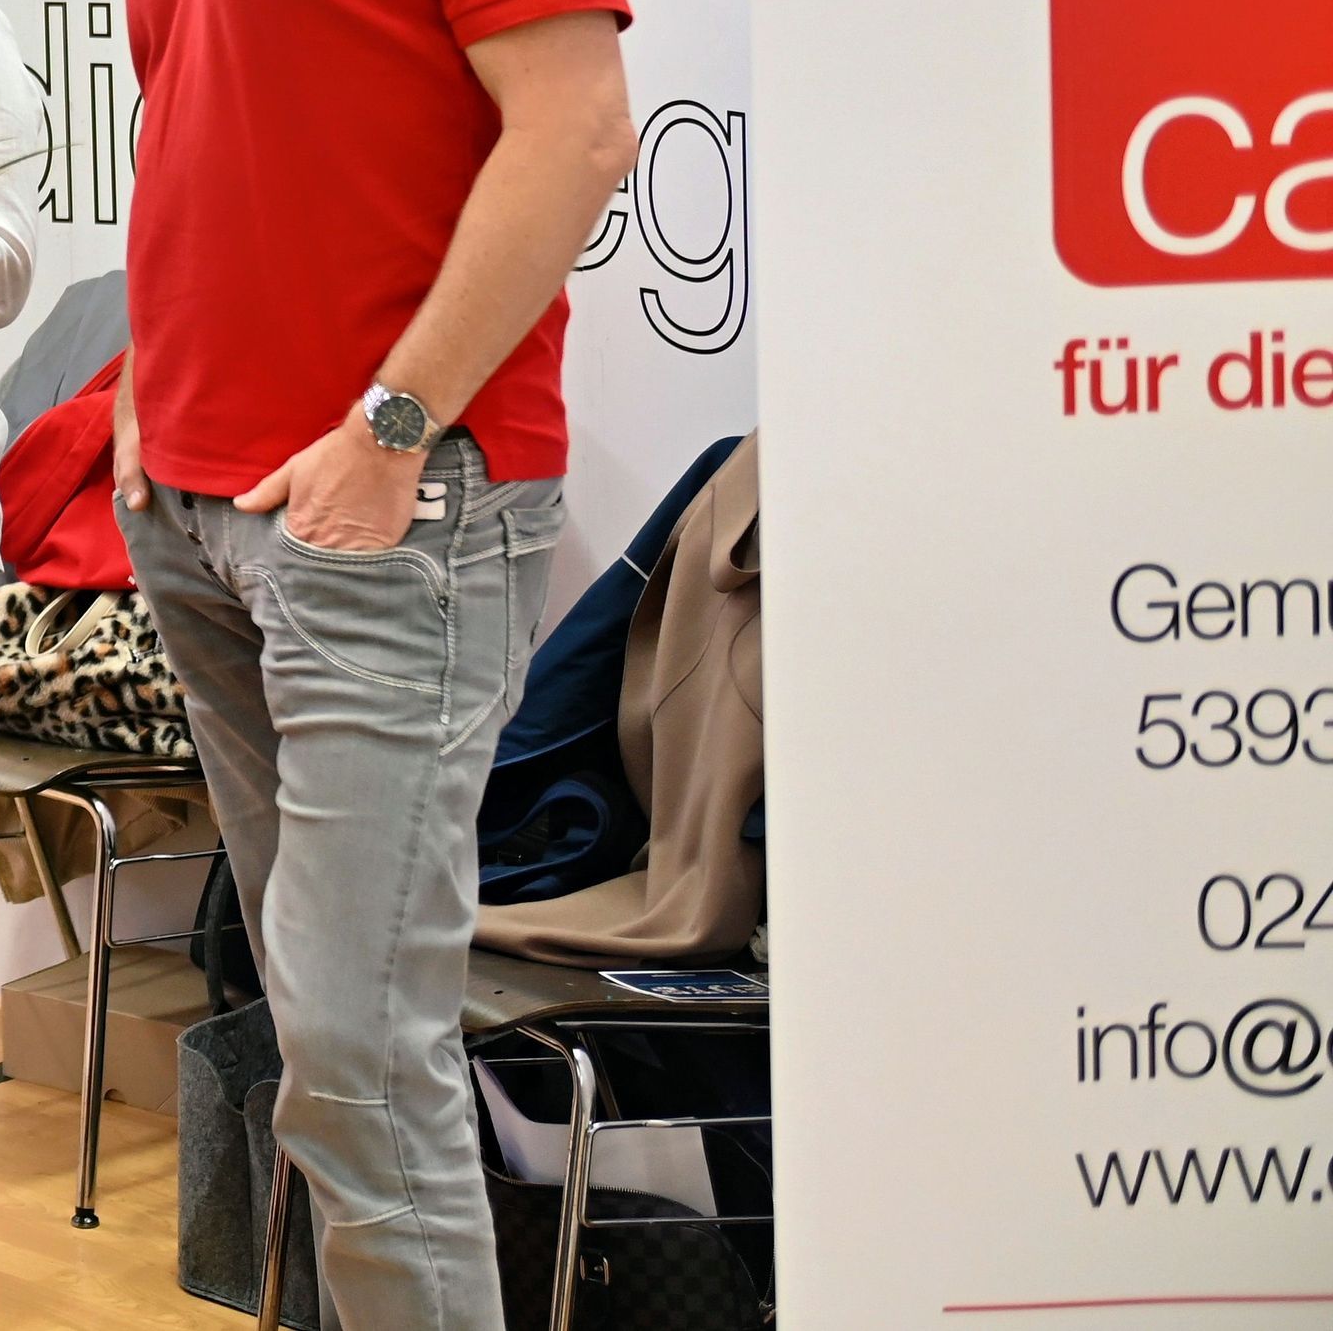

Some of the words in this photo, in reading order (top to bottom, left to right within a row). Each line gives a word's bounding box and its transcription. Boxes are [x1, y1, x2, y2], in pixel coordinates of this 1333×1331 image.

[1053, 336, 1179, 416] für
[1206, 330, 1333, 411] die
[1076, 997, 1333, 1098] info@
[1075, 1145, 1333, 1208] www.
